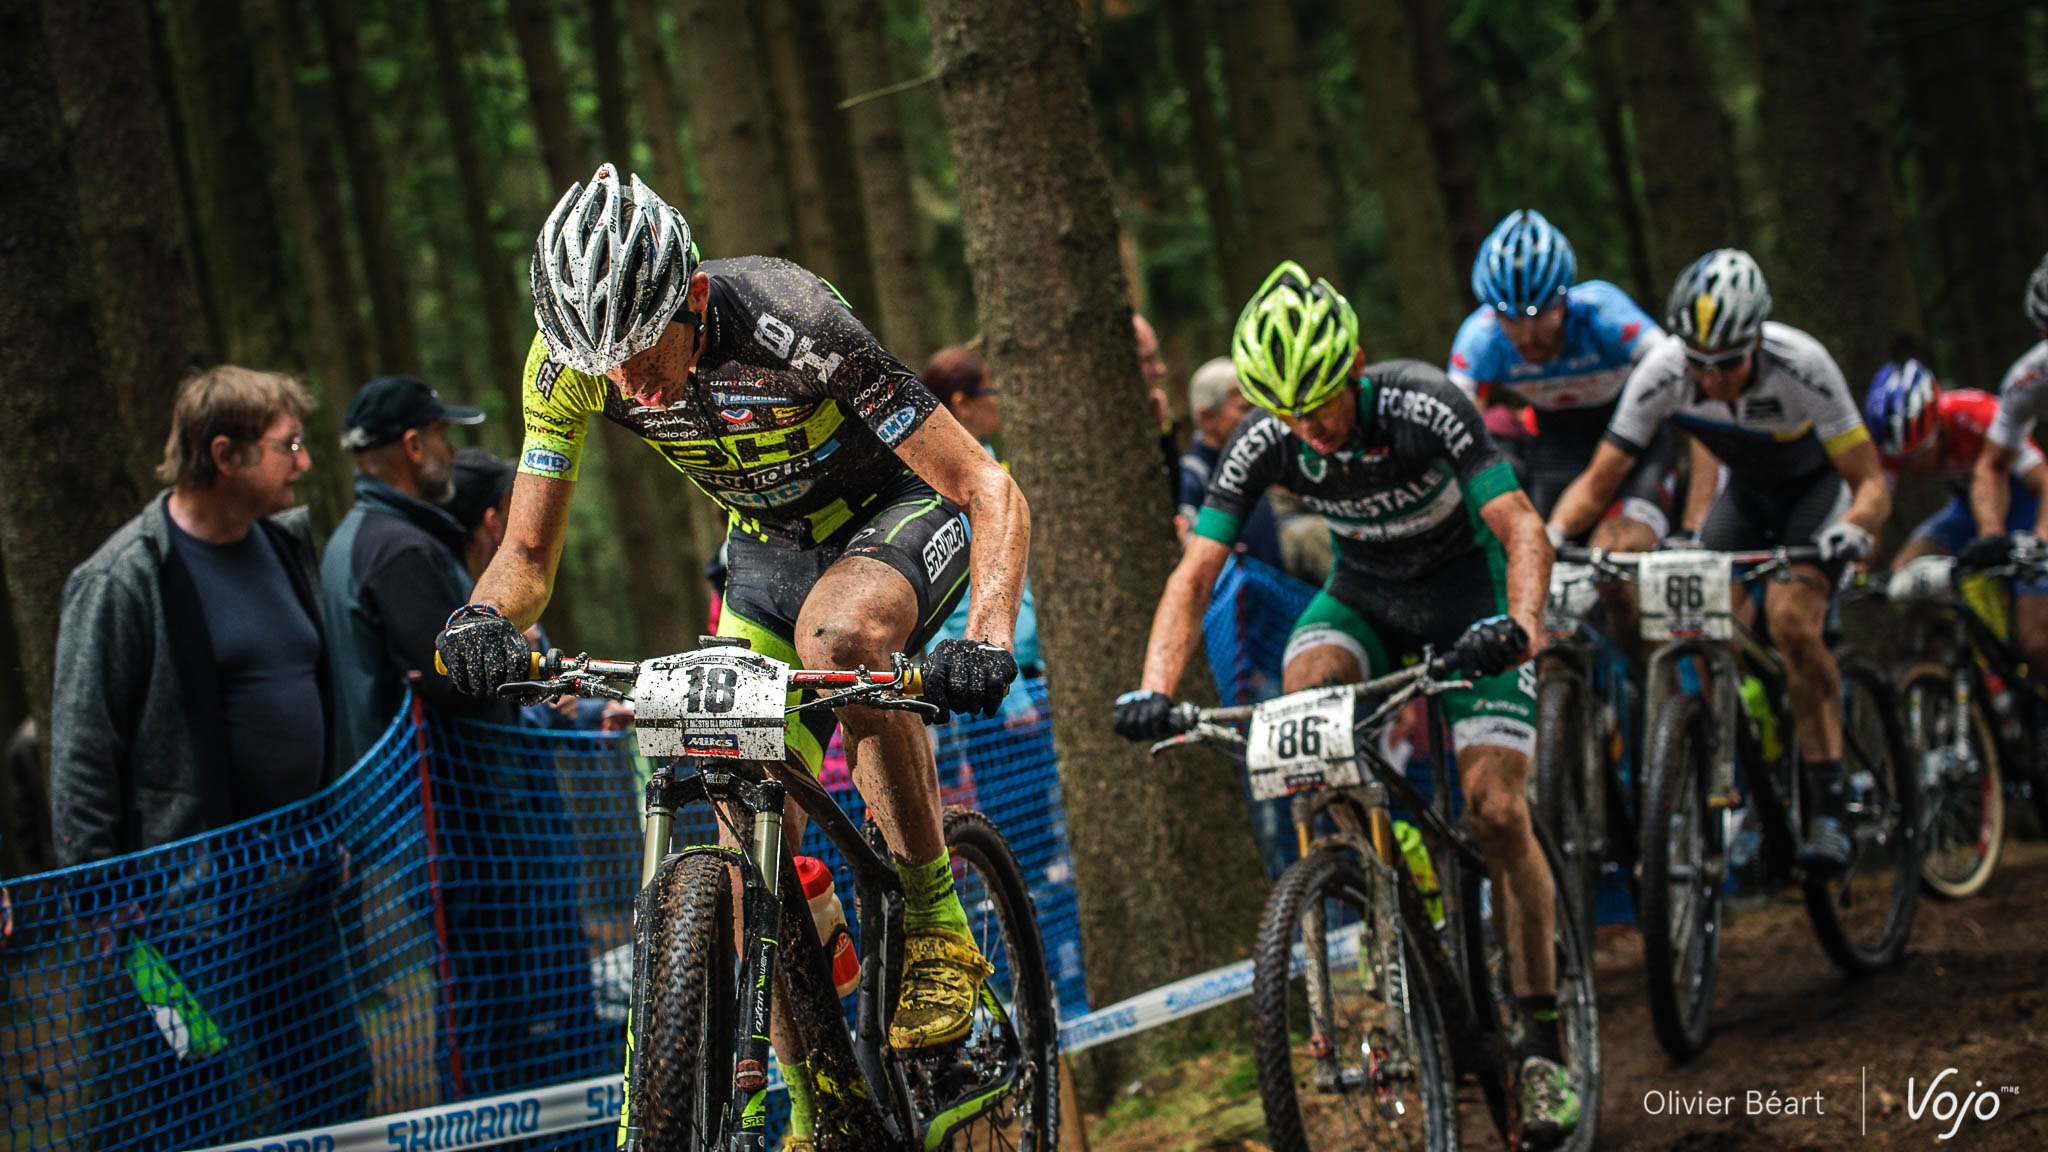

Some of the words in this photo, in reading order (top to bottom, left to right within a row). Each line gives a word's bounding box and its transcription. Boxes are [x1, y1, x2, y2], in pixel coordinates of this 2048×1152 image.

[1378, 386, 1474, 458] FORESTALE
[660, 427, 810, 471] BH
[686, 666, 738, 713] 18
[1278, 716, 1321, 760] 86
[388, 1097, 541, 1151] SHIMANO
